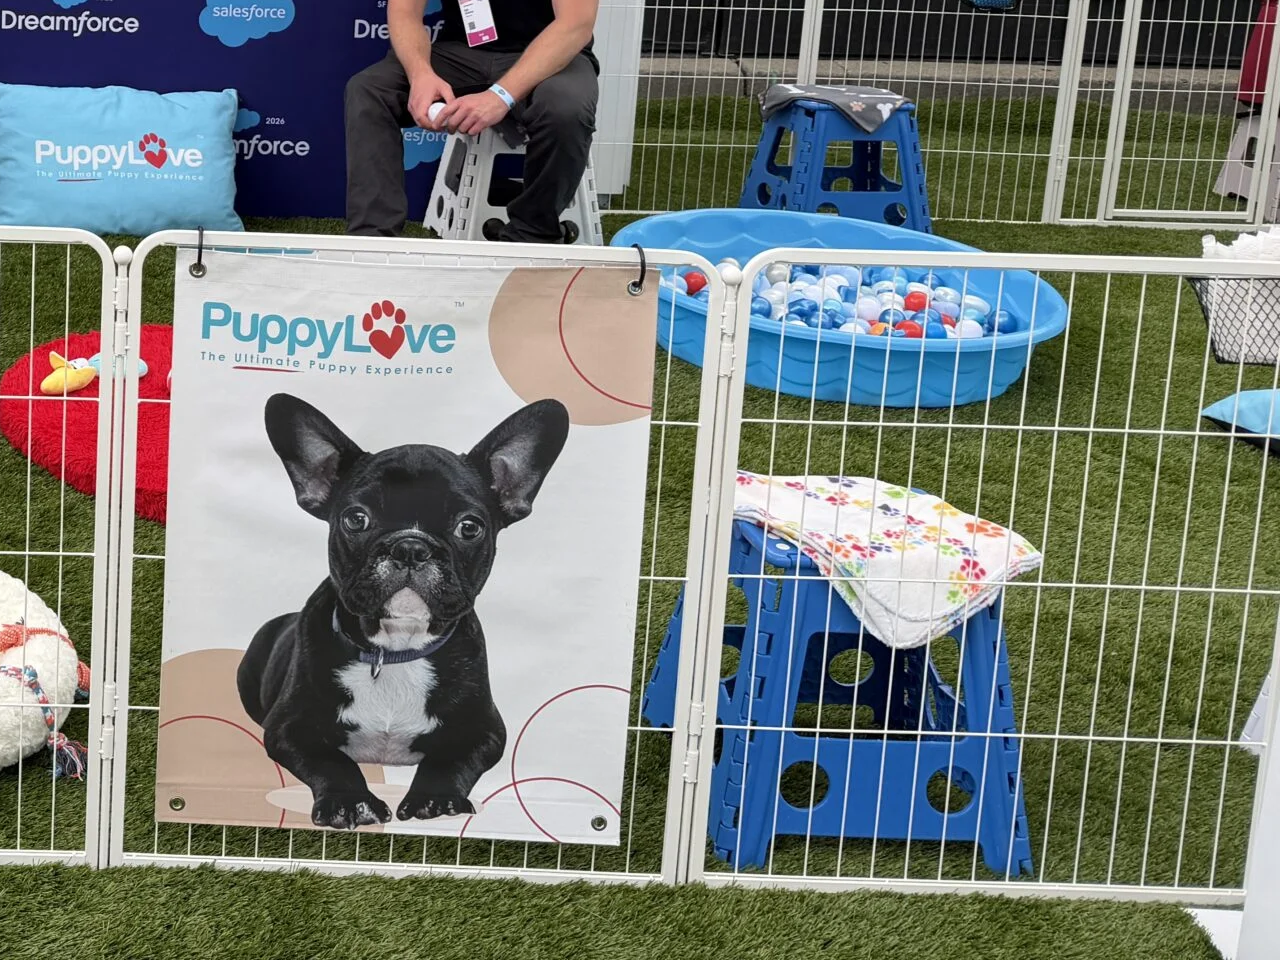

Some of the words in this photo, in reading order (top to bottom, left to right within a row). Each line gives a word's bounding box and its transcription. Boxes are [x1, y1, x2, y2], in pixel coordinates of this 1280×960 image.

[213, 5, 285, 21] salesforce
[2, 10, 139, 36] Dreamforce
[265, 117, 285, 125] 2026
[36, 170, 53, 178] The
[58, 170, 102, 178] Ultimate
[107, 171, 139, 180] Puppy
[144, 172, 204, 181] Experience
[201, 351, 226, 362] The
[234, 353, 300, 368] Ultimate
[309, 360, 357, 375] Puppy
[366, 364, 454, 376] Experience
